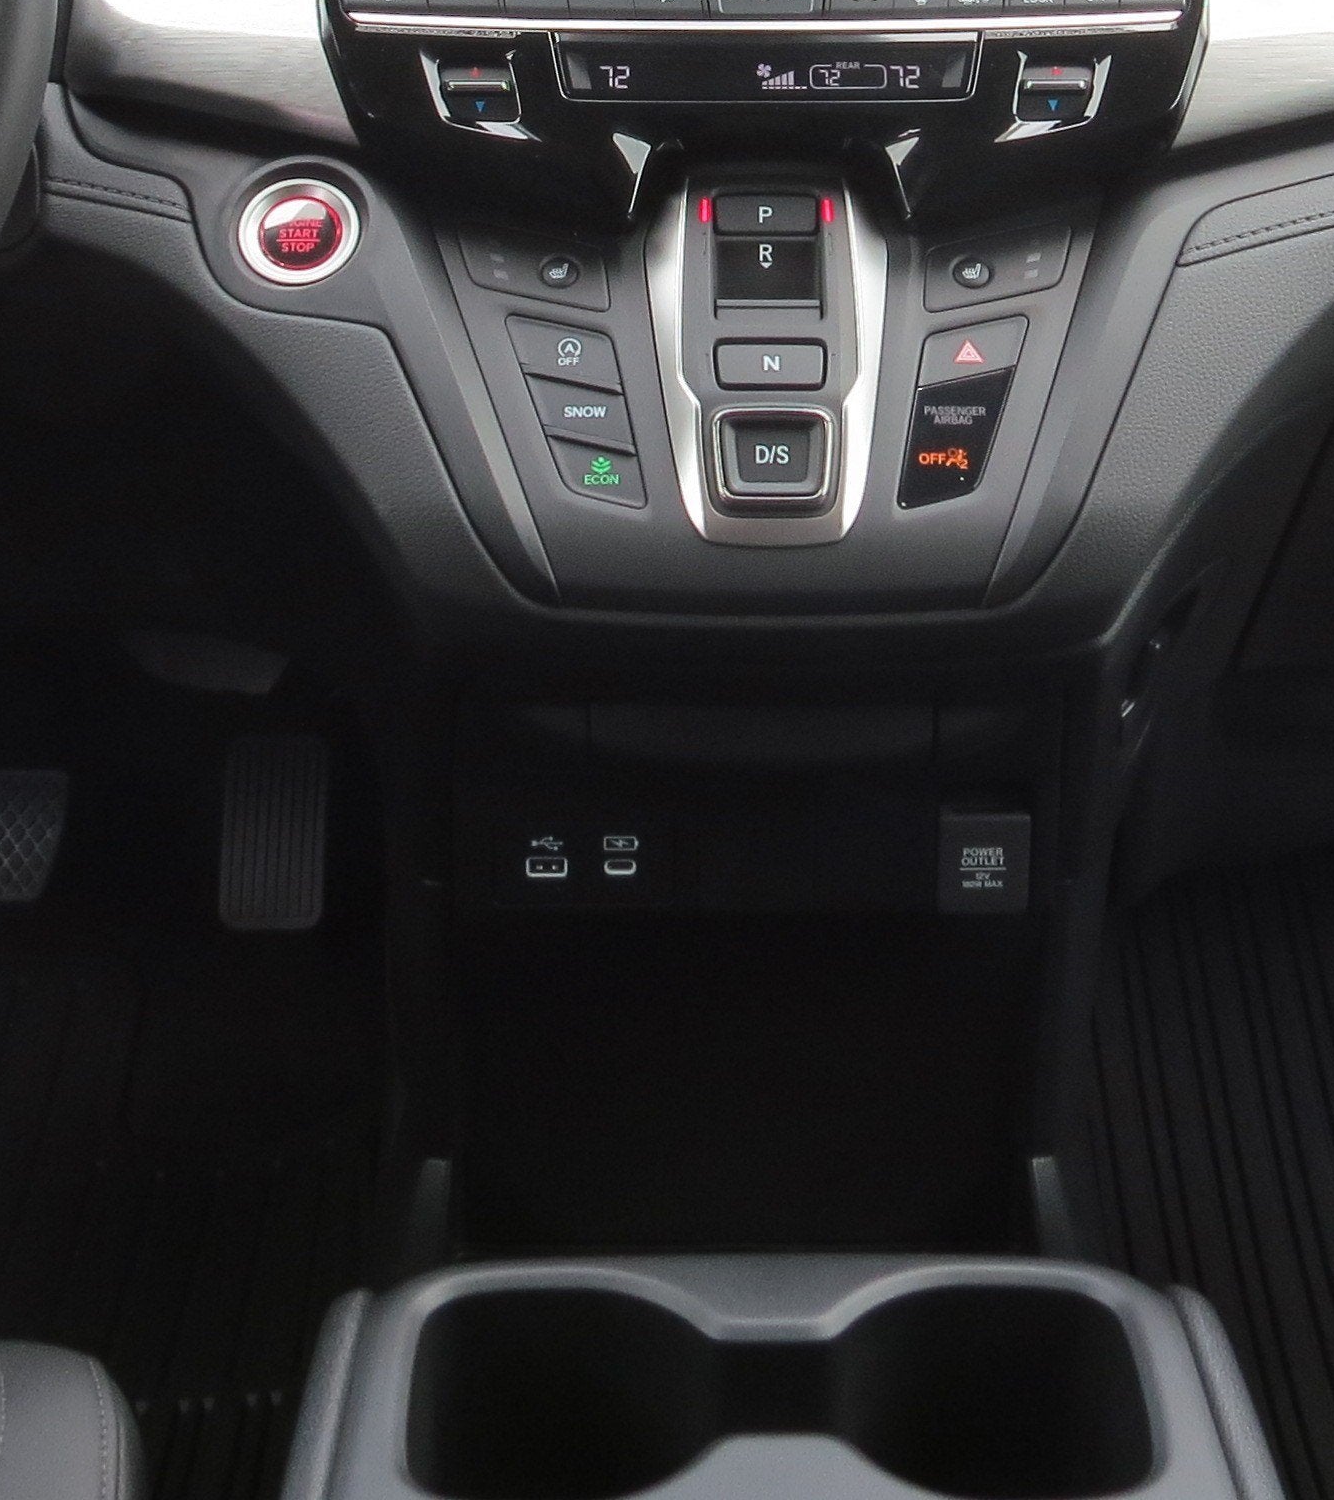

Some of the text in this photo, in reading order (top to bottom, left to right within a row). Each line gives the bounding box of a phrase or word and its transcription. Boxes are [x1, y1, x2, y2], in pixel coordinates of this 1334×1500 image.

[835, 61, 861, 70] REAR
[599, 65, 630, 89] 72
[818, 69, 841, 87] 72
[889, 65, 921, 89] 72
[758, 206, 772, 224] P
[279, 228, 318, 239] START
[281, 242, 315, 253] STOP
[758, 244, 773, 263] R
[557, 358, 580, 366] OFF
[764, 355, 780, 372] N
[564, 406, 606, 418] SNOW
[924, 405, 987, 417] PASSENGER
[933, 414, 973, 425] AIRBAG
[755, 445, 790, 465] D/S
[918, 452, 947, 465] OFF
[584, 474, 619, 485] ECON
[963, 847, 1004, 857] POWER
[961, 857, 1005, 867] OUTLET
